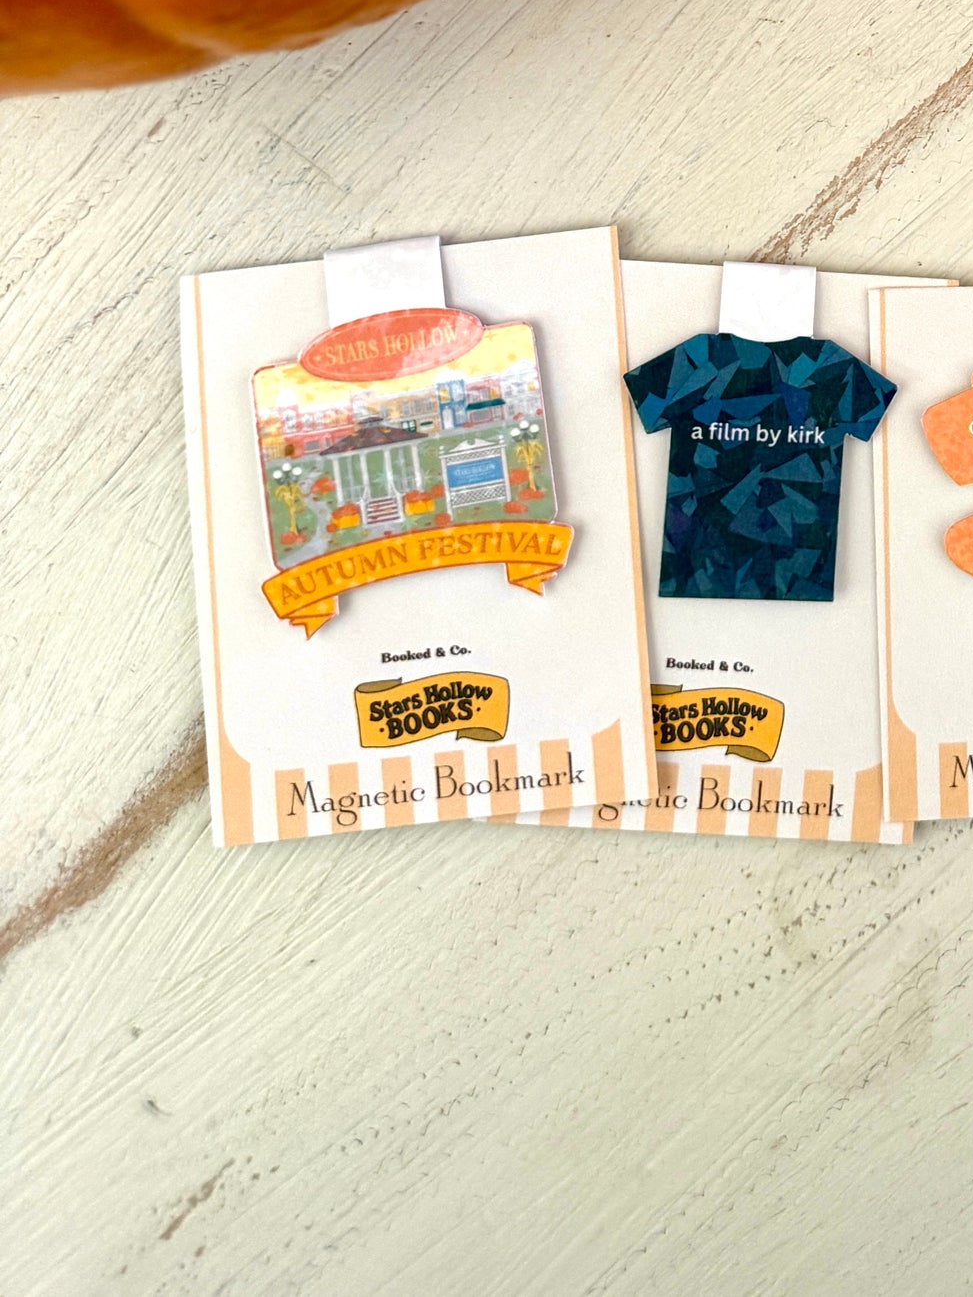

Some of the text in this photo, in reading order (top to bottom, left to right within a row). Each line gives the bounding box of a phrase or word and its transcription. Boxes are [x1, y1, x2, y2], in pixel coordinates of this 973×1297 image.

[325, 324, 457, 366] STARS HOLLOW
[691, 422, 825, 448] a film by kirk
[279, 531, 562, 606] AUTUMN FESTIVAL
[381, 645, 472, 664] Booked & Co.
[665, 657, 754, 672] Booked & Co.
[369, 681, 493, 722] Stars Hollow
[386, 698, 474, 740] BOOKS
[701, 697, 768, 721] Hollow
[660, 716, 747, 744] BOOKS
[287, 753, 585, 826] Magnetic Bookmark
[698, 776, 844, 819] Bookmark
